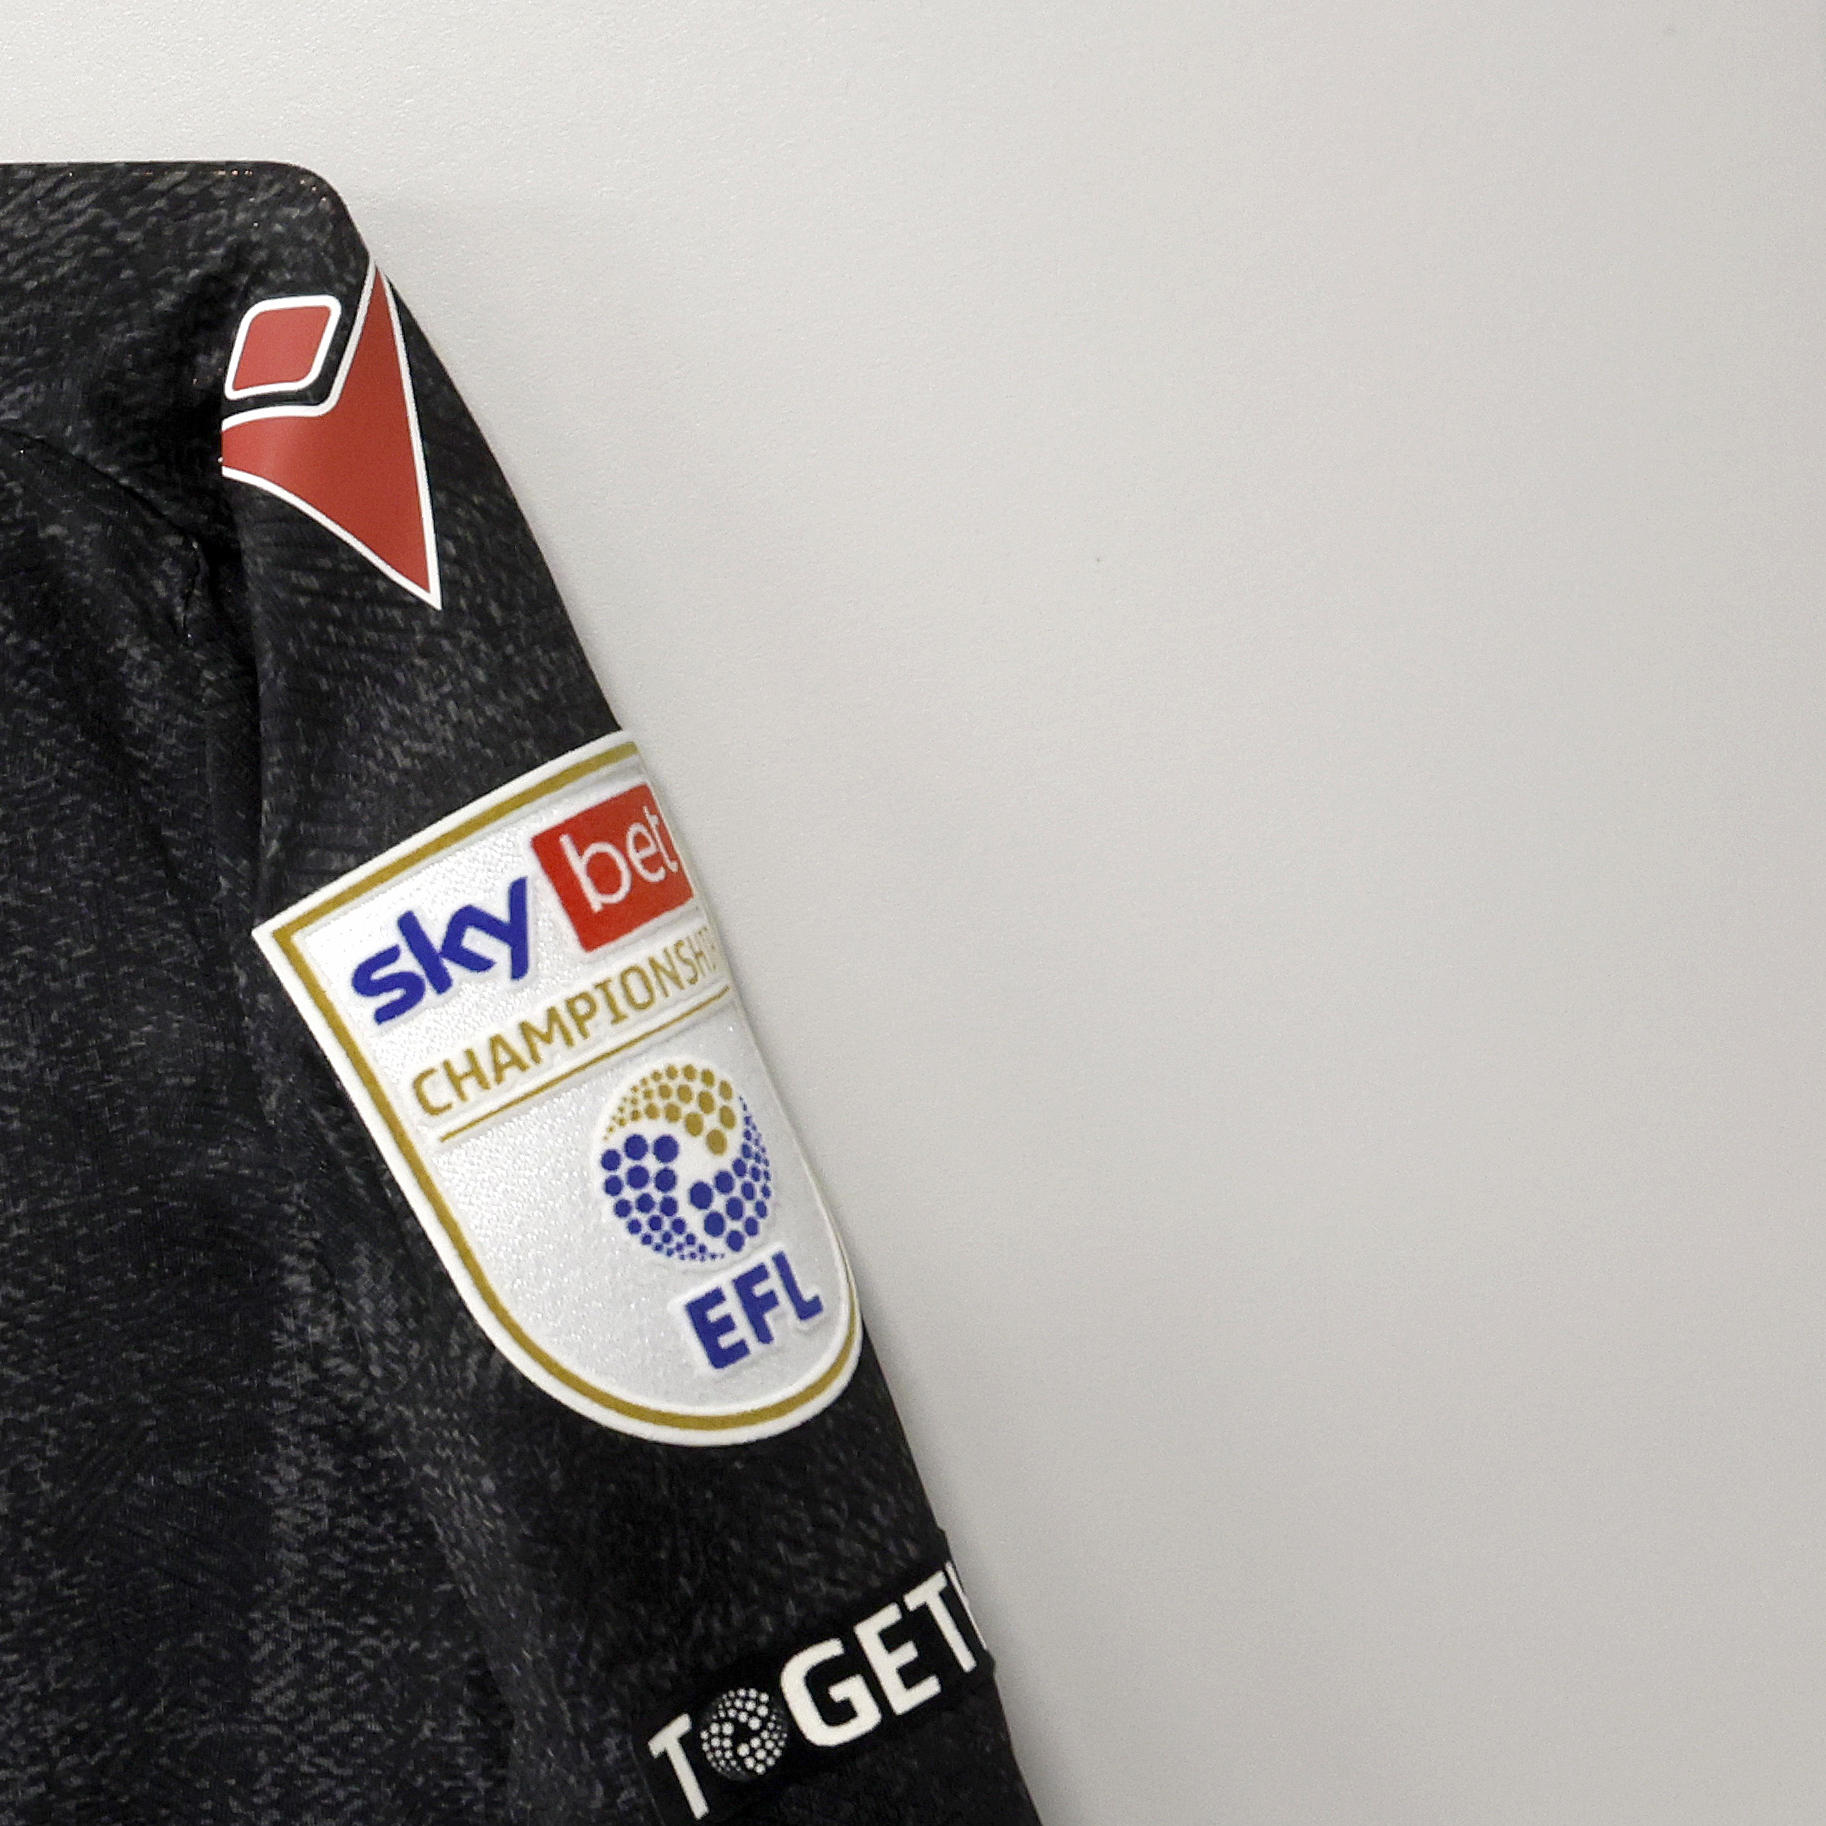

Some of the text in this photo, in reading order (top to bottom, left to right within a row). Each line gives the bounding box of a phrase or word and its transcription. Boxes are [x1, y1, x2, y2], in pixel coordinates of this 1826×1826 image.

[351, 806, 679, 1025] sky bet
[684, 1250, 824, 1370] EFL
